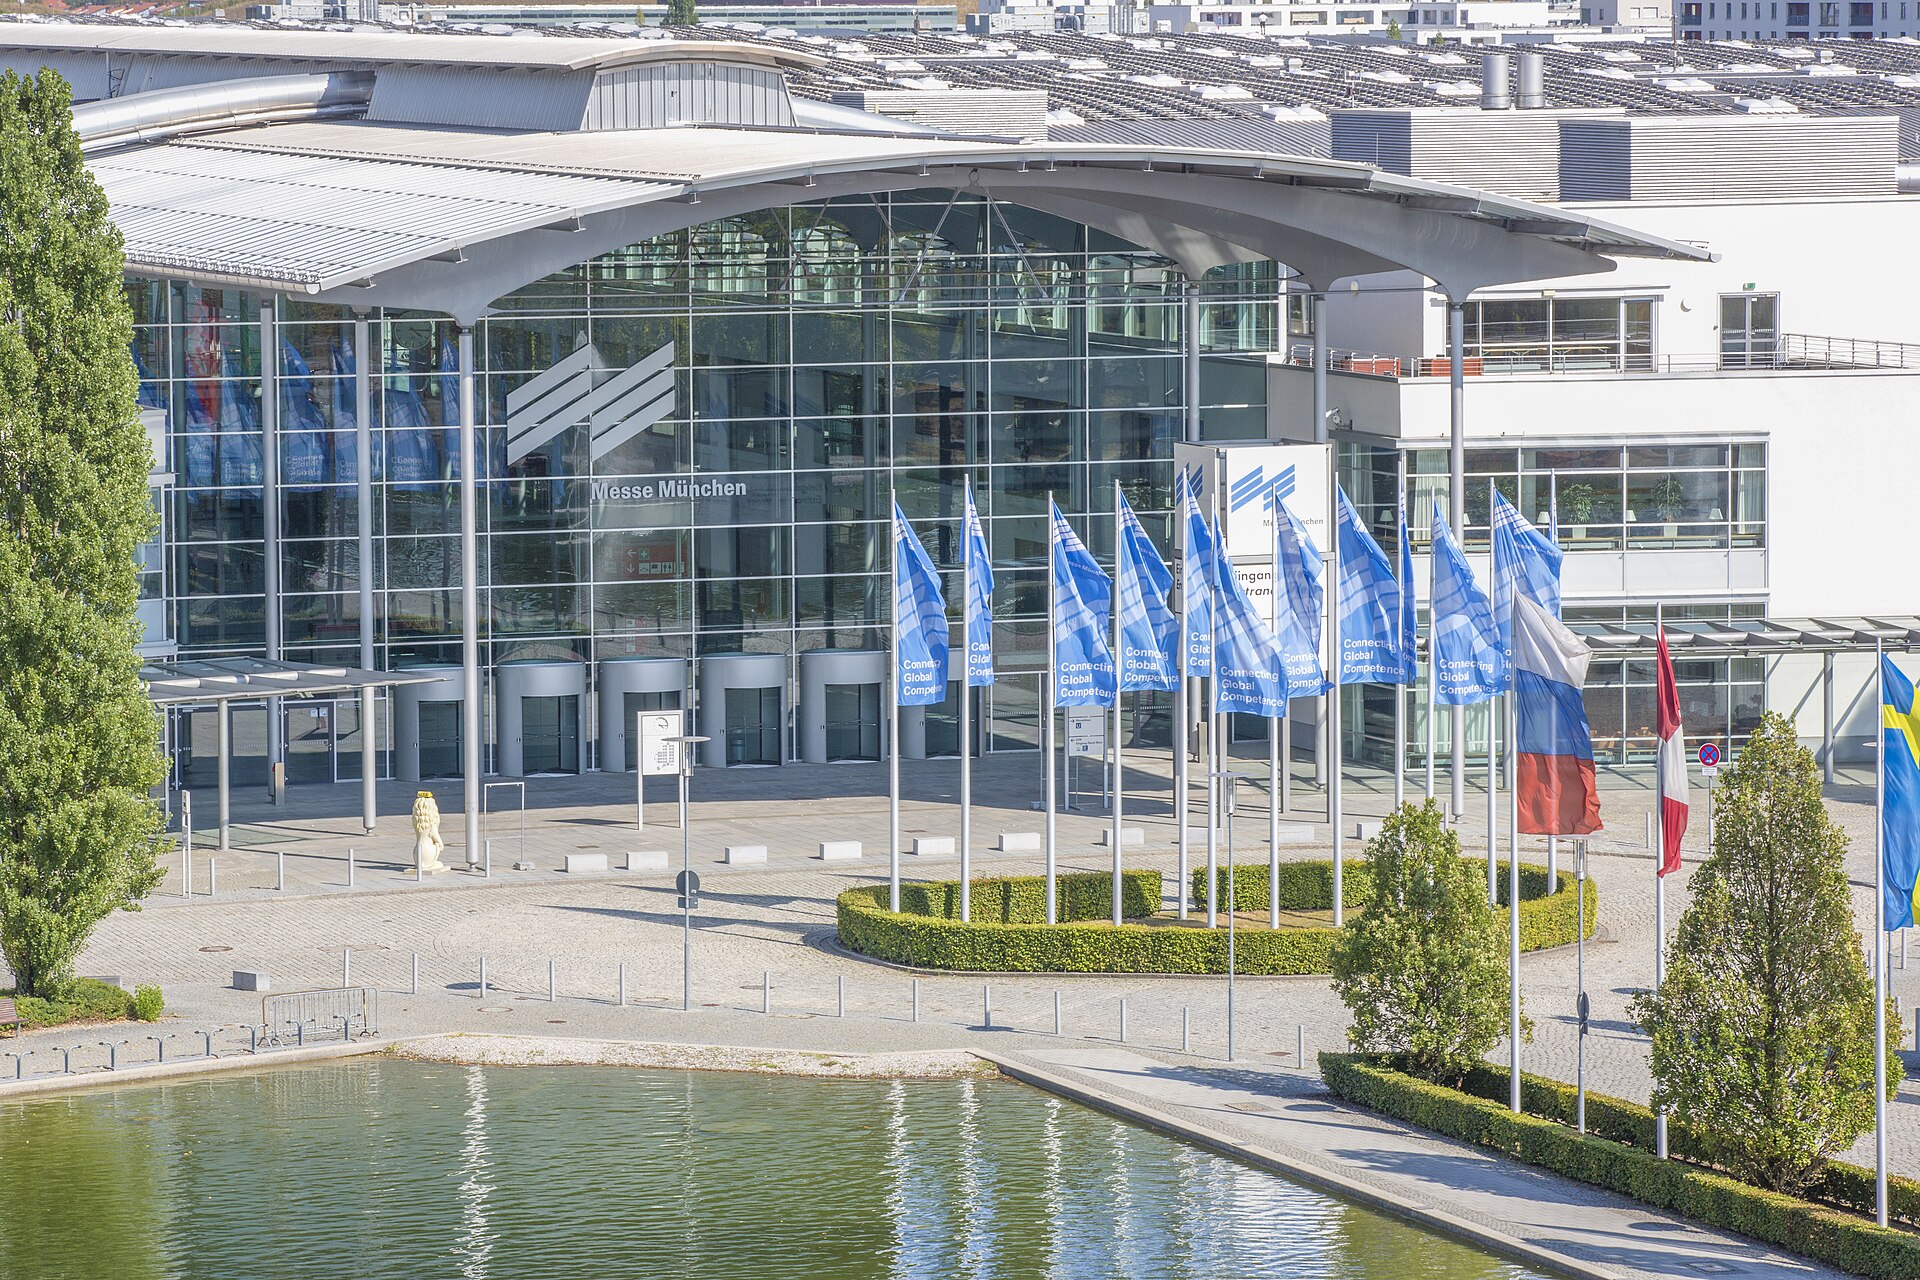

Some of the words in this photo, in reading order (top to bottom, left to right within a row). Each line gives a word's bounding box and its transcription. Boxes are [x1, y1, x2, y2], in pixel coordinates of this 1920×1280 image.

[591, 482, 653, 500] Messe
[658, 479, 747, 498] München
[1234, 570, 1271, 584] ingan
[1343, 639, 1397, 653] Connecting
[1343, 651, 1374, 661] Global
[1221, 667, 1279, 683] Connecting
[1343, 665, 1405, 676] Competence
[903, 671, 933, 682] Global
[1060, 673, 1093, 684] Global
[1439, 671, 1470, 682] Global
[1222, 679, 1255, 690] Global
[1060, 687, 1116, 699] Competenc
[1221, 692, 1284, 707] Competence
